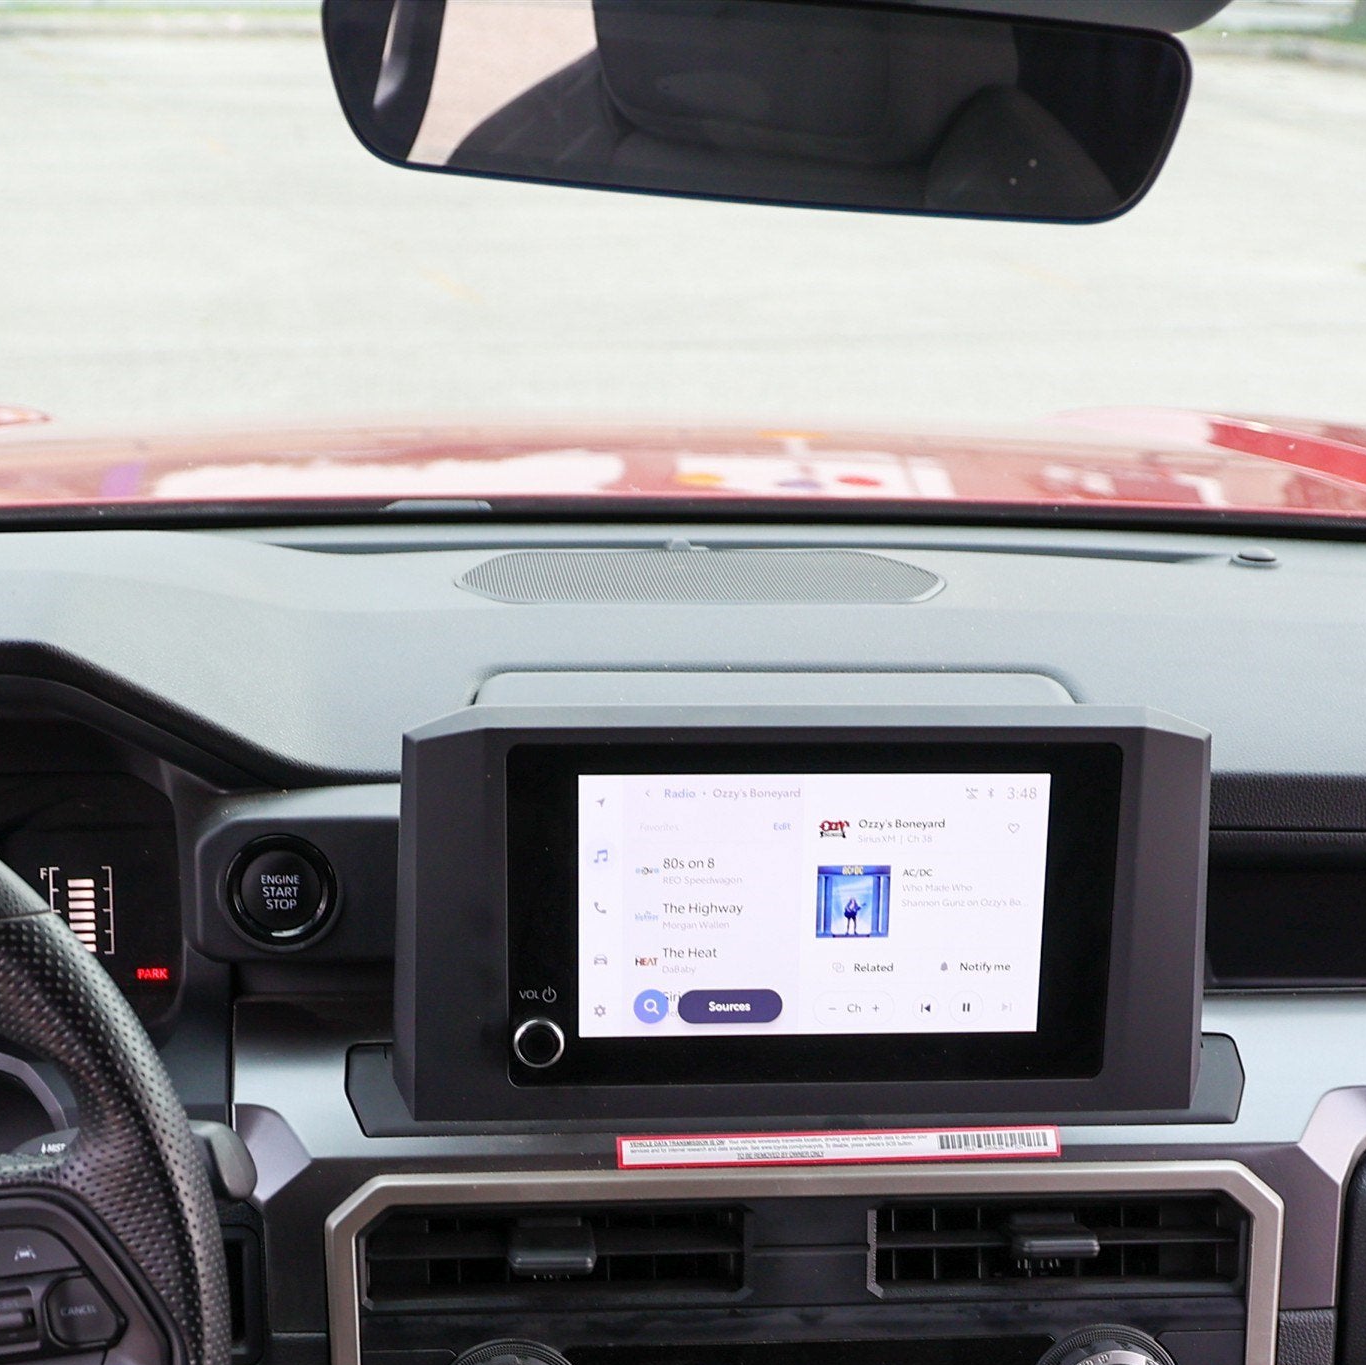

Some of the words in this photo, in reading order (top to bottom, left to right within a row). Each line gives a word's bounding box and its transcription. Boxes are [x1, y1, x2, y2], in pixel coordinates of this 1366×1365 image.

[664, 788, 696, 799] Radio
[712, 788, 748, 800] Ozzy's
[749, 788, 802, 800] Boneyard
[1006, 787, 1038, 800] 3:48
[772, 822, 792, 831] Edit
[858, 819, 893, 832] Ozzy's
[895, 818, 946, 832] Boneyard
[663, 858, 685, 870] 80s
[688, 860, 705, 870] on
[707, 857, 715, 869] 8
[902, 868, 934, 878] AC/DC
[260, 874, 301, 886] ENGINE
[262, 886, 299, 898] START
[266, 898, 298, 910] STOP
[662, 902, 685, 914] The
[688, 902, 744, 916] Highway
[662, 947, 685, 958] The
[688, 947, 718, 958] Heat
[853, 962, 895, 973] Related
[959, 962, 992, 974] Notify
[993, 963, 1011, 972] me
[136, 968, 169, 981] PARK
[519, 989, 540, 1000] VOL
[708, 1001, 752, 1013] Sources
[846, 1003, 862, 1014] Ch
[60, 1304, 97, 1317] CANCEL
